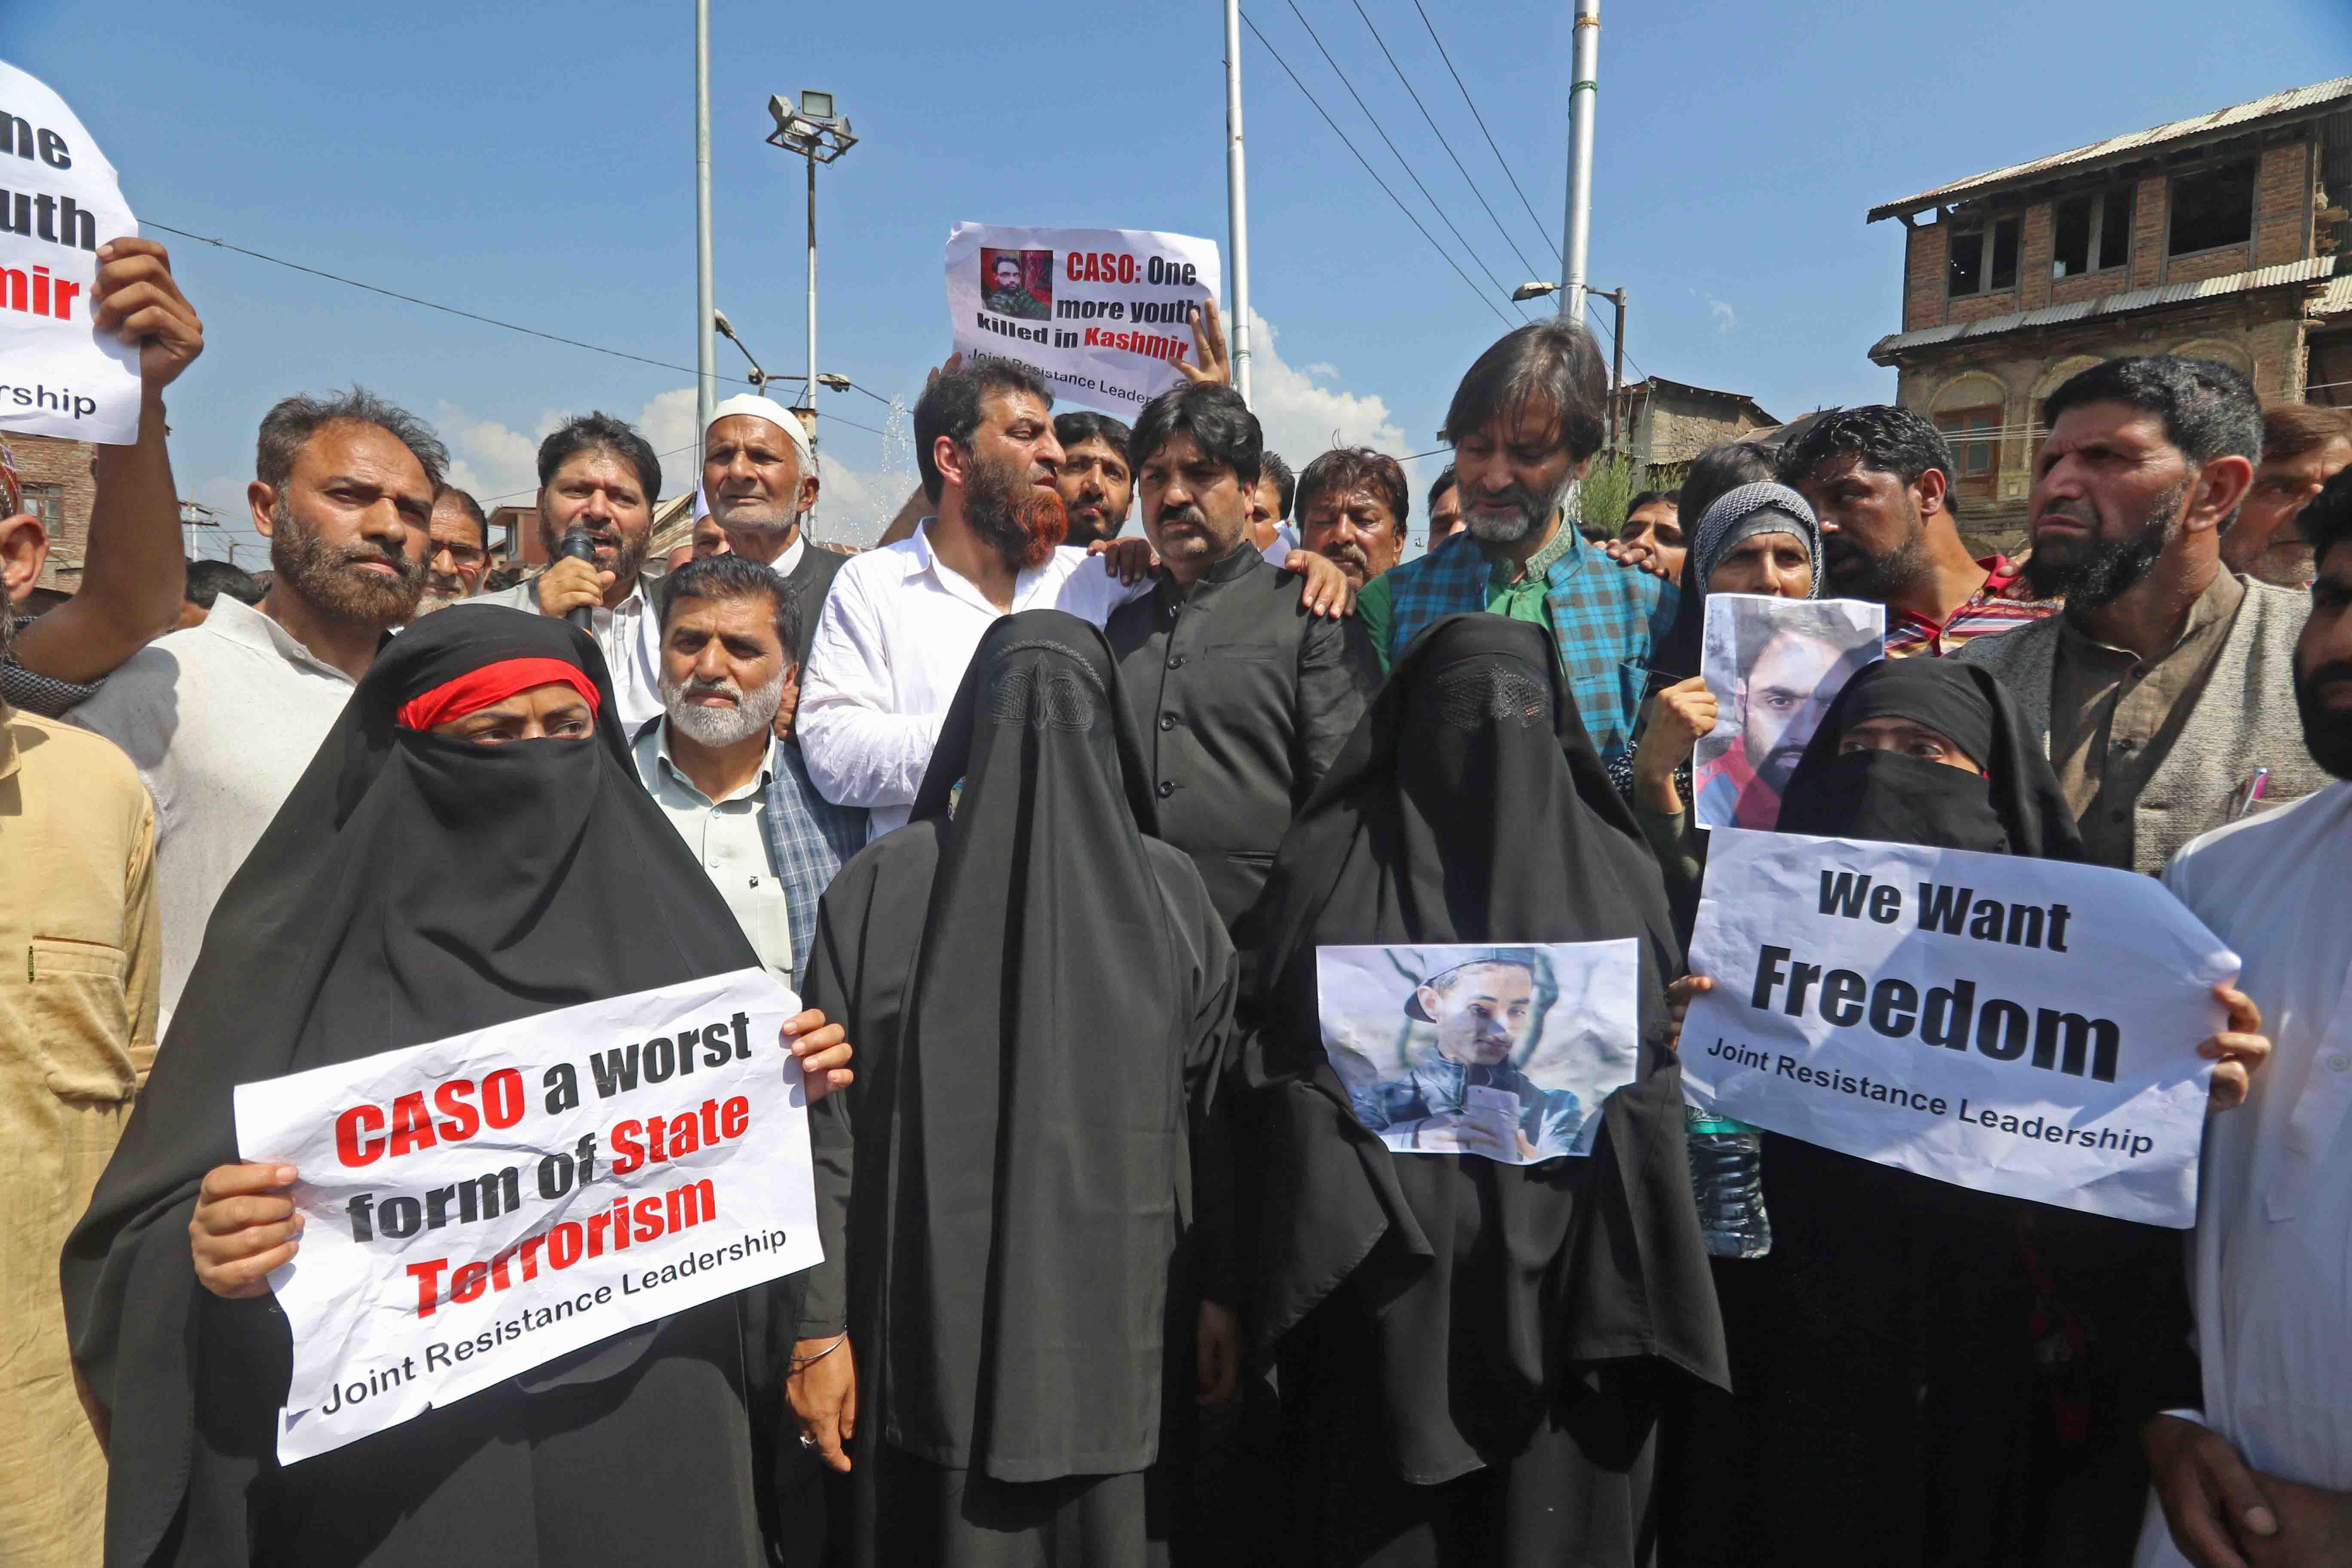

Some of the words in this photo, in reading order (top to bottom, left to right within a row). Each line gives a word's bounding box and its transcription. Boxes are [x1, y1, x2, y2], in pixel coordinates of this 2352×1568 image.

[0, 110, 71, 170] ne
[0, 189, 96, 252] uth
[1066, 251, 1142, 284] CASO:
[1147, 256, 1197, 286] One
[977, 312, 1048, 345] killed
[1054, 329, 1078, 348] in
[1084, 327, 1188, 361] Kashmir
[1056, 300, 1124, 320] more
[1130, 299, 1200, 325] youth
[0, 384, 96, 420] rship
[1100, 380, 1153, 404] Leader
[1818, 870, 1901, 925] We
[1917, 882, 2071, 953] Want
[1751, 944, 2120, 1084] Freedom
[335, 1067, 526, 1168] CASO
[543, 1062, 579, 1116] a
[589, 1011, 752, 1099] worst
[1707, 1037, 1768, 1072] Joint
[1776, 1055, 1947, 1116] Resistance
[1959, 1098, 2154, 1158] Leadership
[345, 1165, 521, 1243] form
[537, 1132, 597, 1200] of
[610, 1095, 750, 1176] State
[406, 1178, 717, 1319] Terrorism
[322, 1356, 416, 1415] Joint
[426, 1284, 612, 1372] Resistance
[622, 1228, 787, 1295] Leadership
